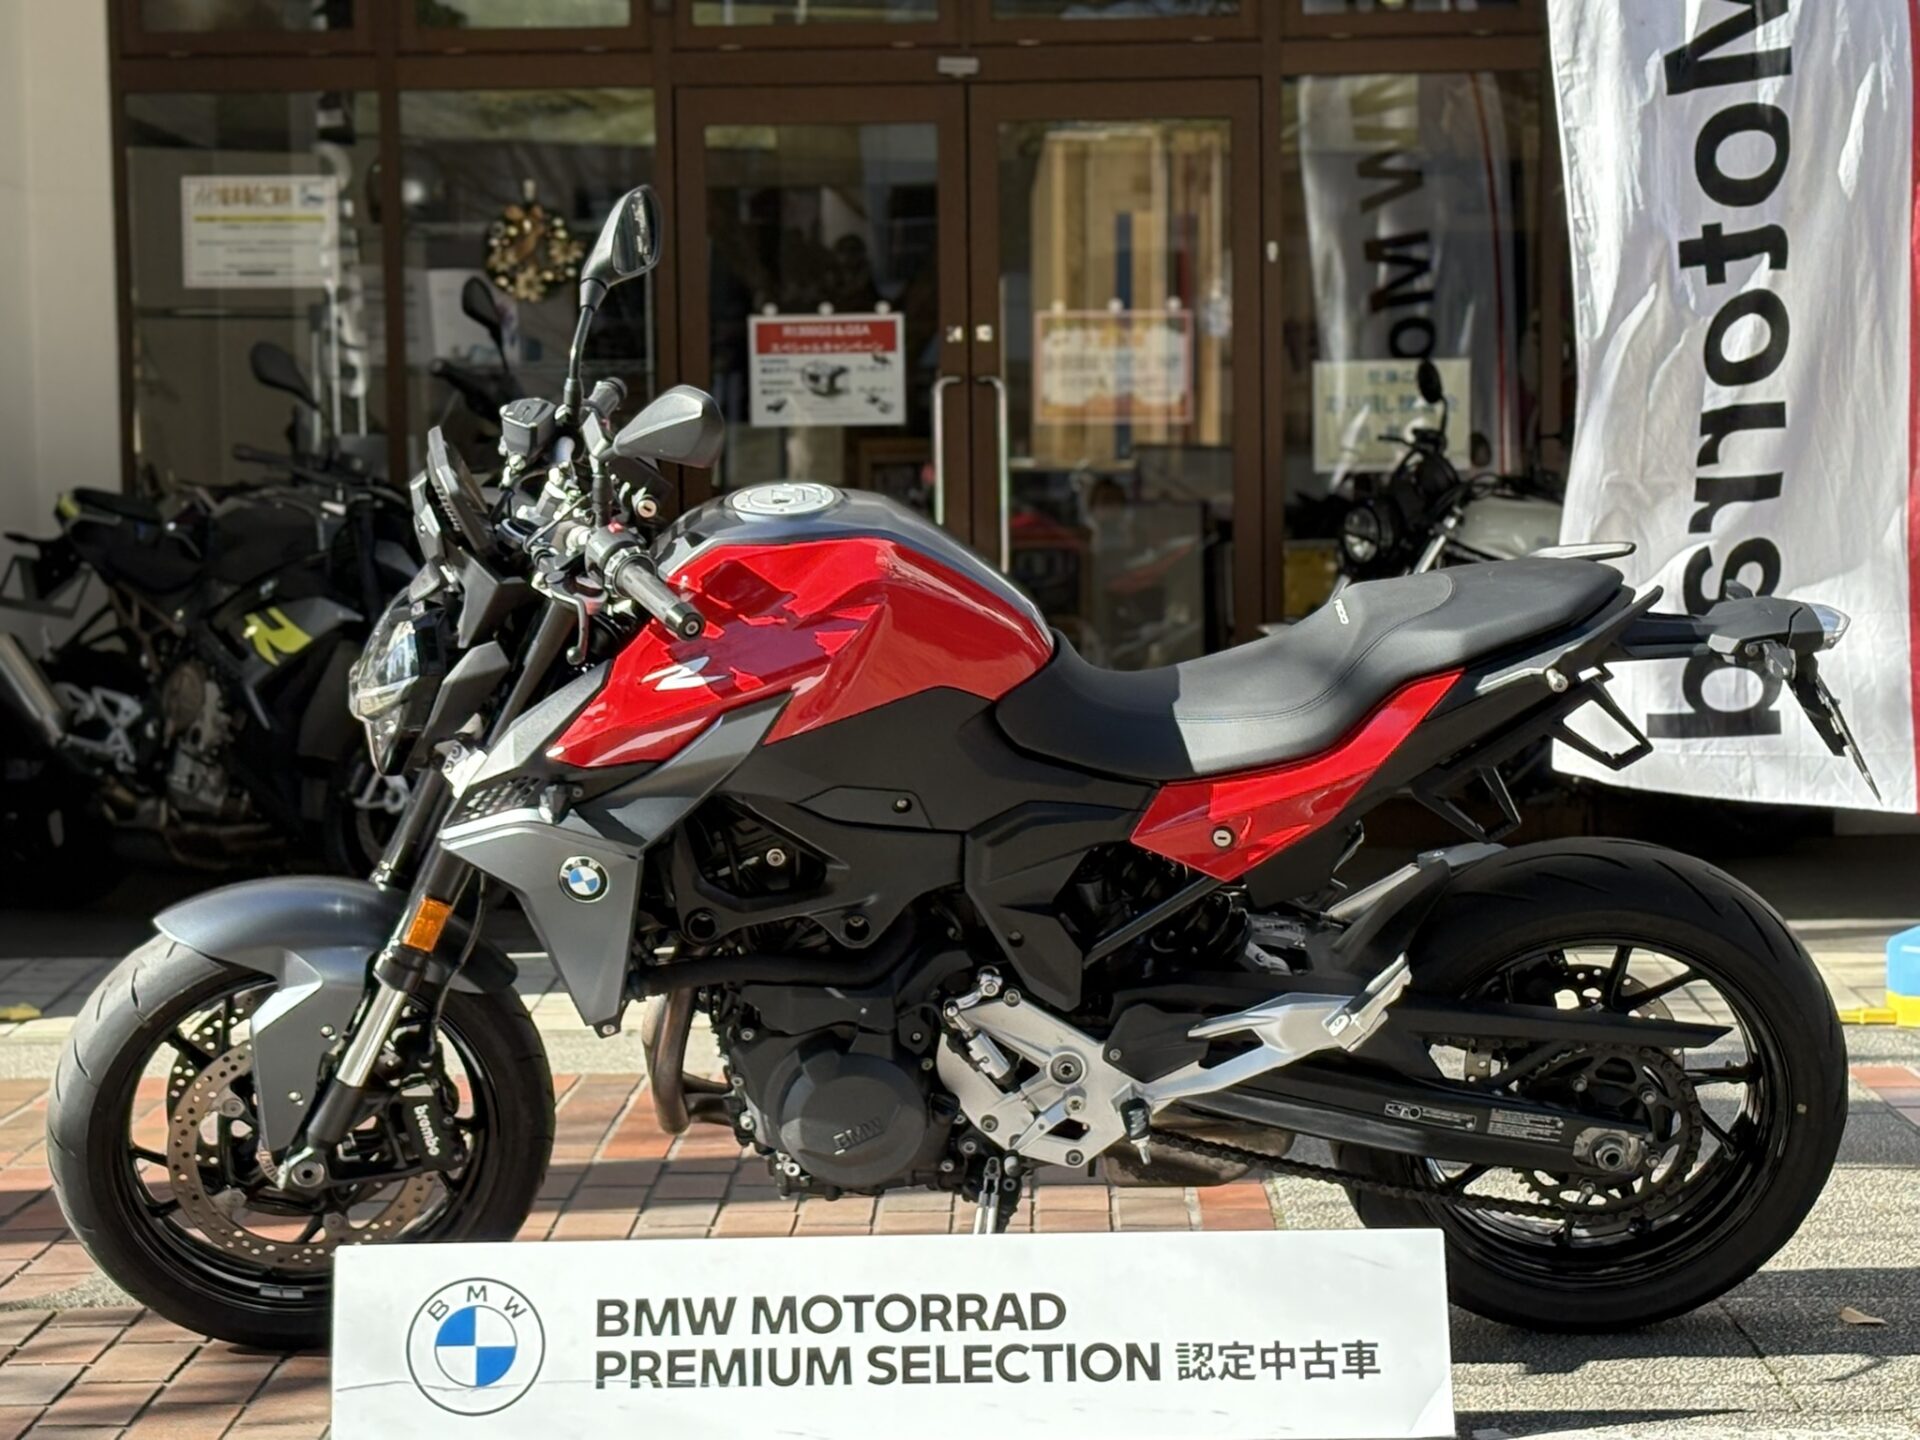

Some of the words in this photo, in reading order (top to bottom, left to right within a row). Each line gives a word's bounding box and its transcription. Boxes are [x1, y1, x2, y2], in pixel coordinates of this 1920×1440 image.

[413, 1103, 441, 1156] brembo
[832, 1116, 883, 1156] BMW
[427, 1285, 528, 1322] BMW
[596, 1296, 737, 1337] BMW
[751, 1292, 1067, 1335] MOTORRAD
[595, 1346, 853, 1389] PREMIUM
[867, 1342, 1161, 1386] SELECTION
[1175, 1339, 1381, 1381] 認定中古車
